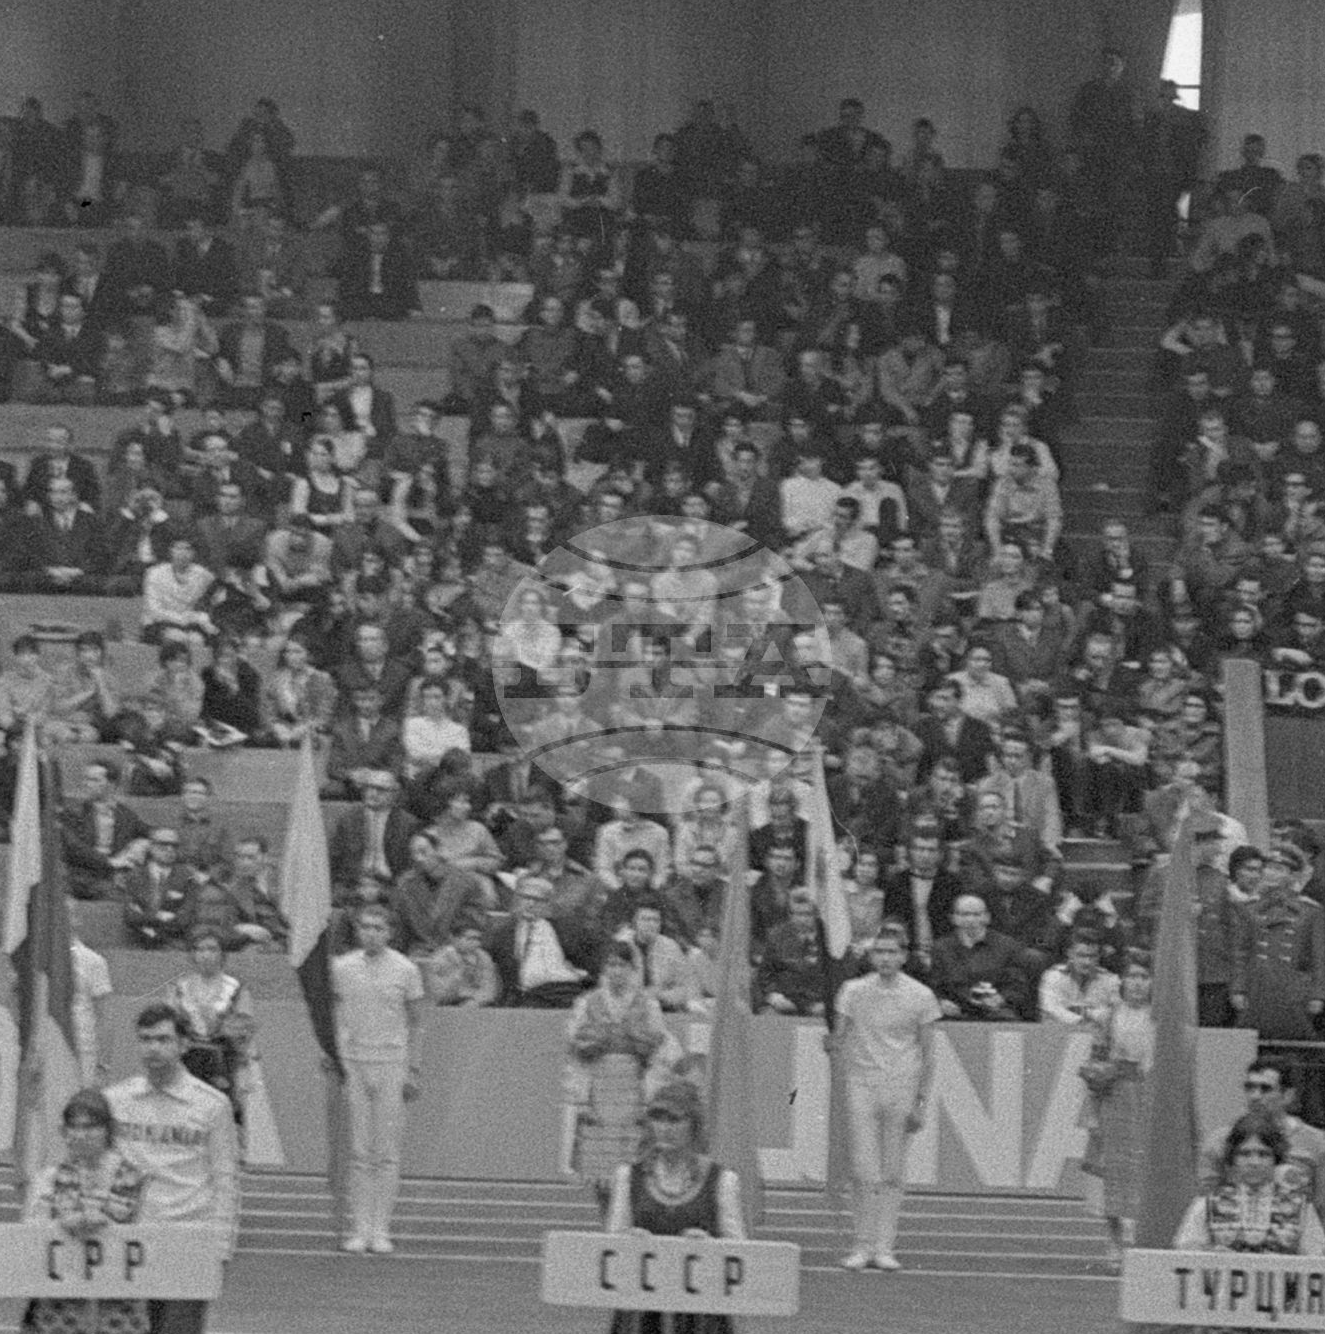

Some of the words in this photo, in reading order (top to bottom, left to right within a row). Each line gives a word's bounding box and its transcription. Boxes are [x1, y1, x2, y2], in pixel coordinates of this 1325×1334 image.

[47, 1238, 145, 1281] СРР
[599, 1248, 745, 1296] СССР
[1173, 1267, 1325, 1321] ТУРЦИЯ
